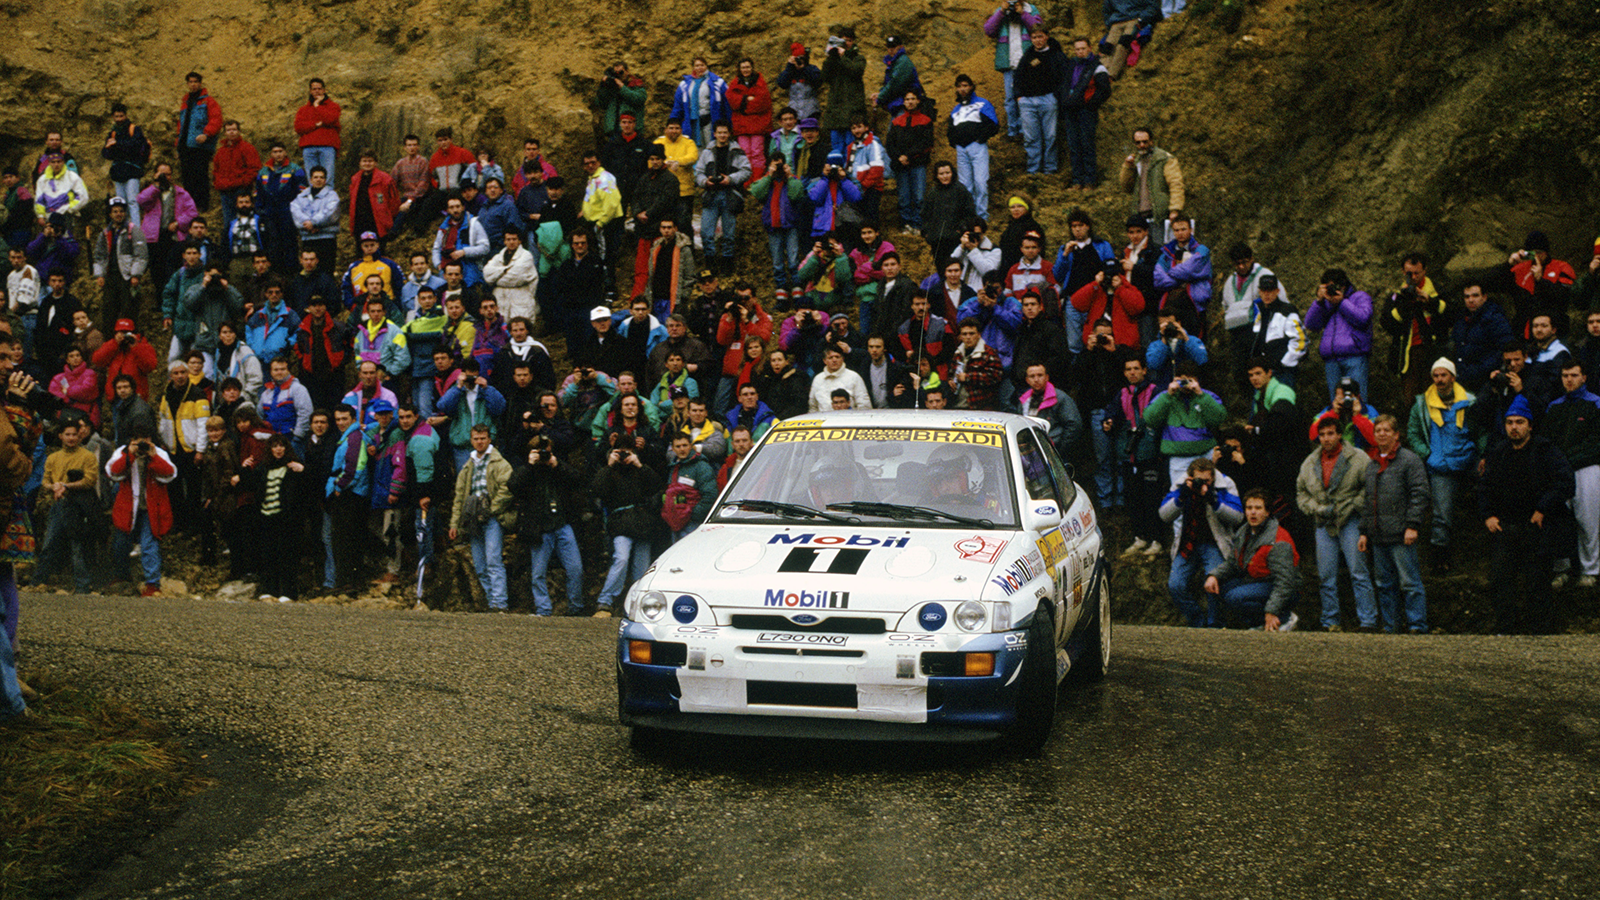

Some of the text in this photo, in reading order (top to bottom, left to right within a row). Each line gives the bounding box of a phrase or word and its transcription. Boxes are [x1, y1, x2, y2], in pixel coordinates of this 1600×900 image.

[773, 429, 854, 443] BRADI
[914, 430, 996, 446] BRADI
[767, 533, 911, 548] Mobil
[808, 549, 841, 573] 1
[991, 563, 1027, 597] Mobil
[760, 633, 805, 642] L730
